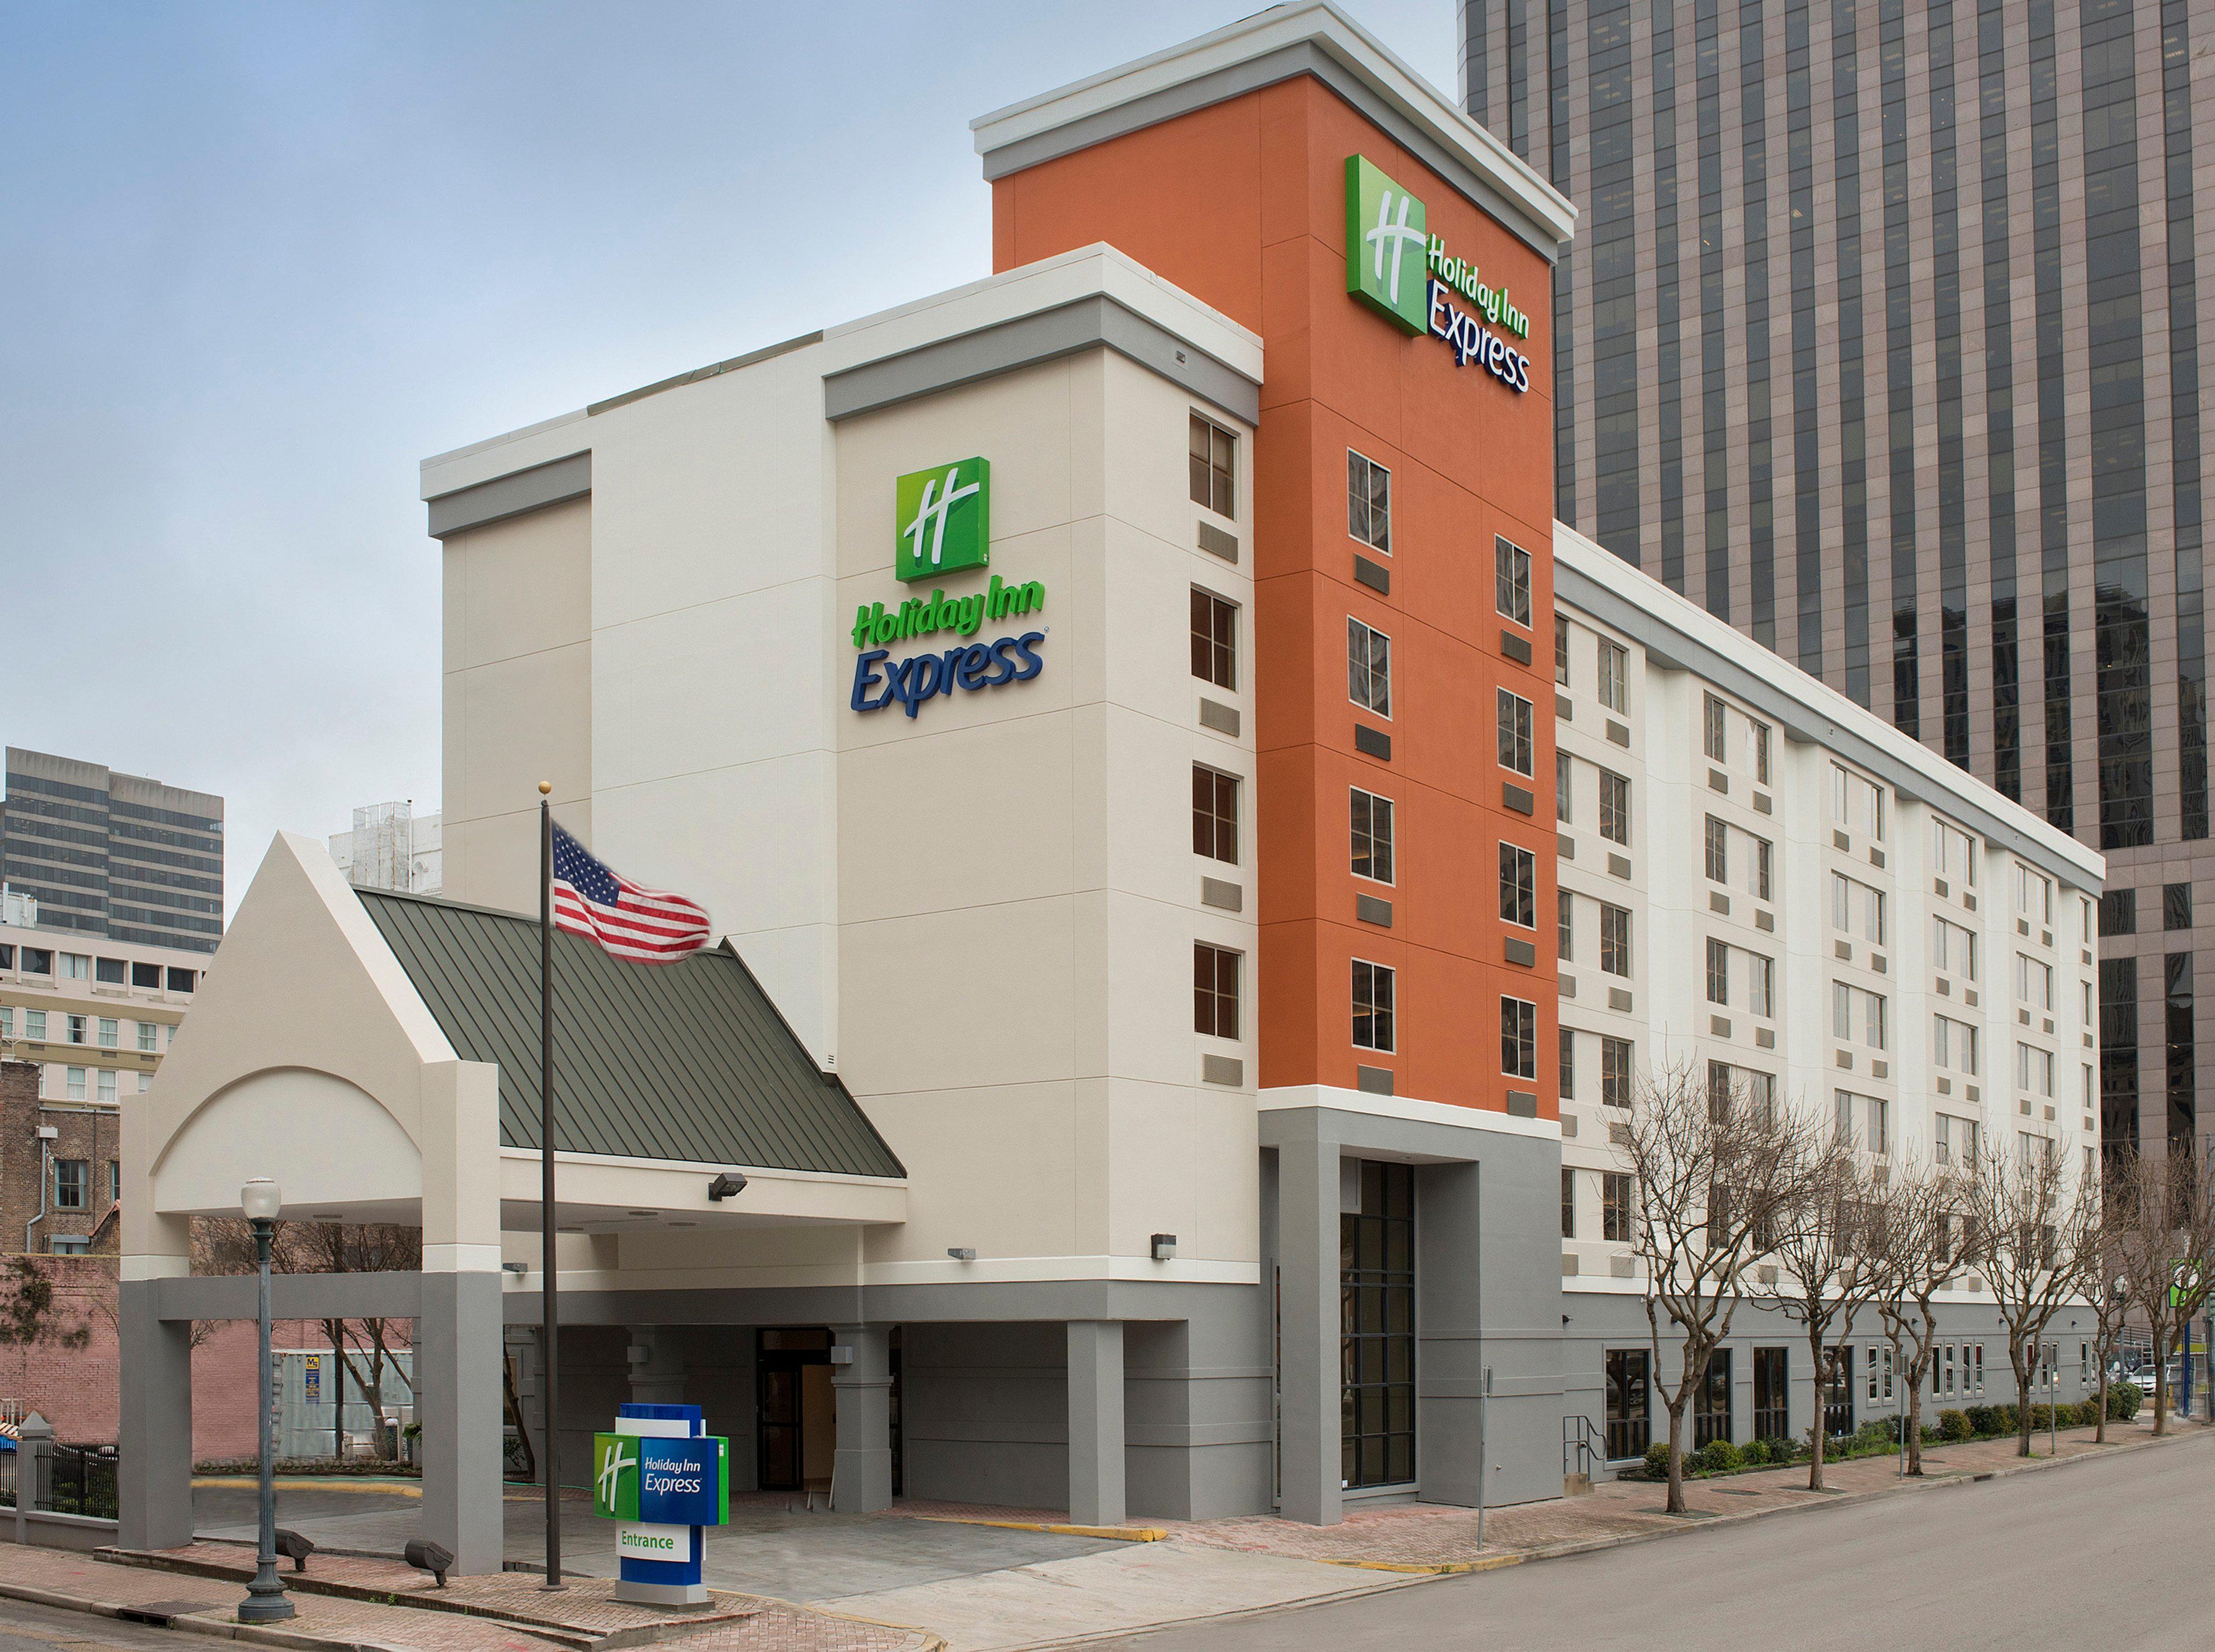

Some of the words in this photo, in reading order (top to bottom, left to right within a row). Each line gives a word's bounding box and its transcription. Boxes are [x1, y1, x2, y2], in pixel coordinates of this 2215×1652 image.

[1426, 233, 1500, 324] Holiday
[1498, 287, 1530, 339] Inn
[1427, 279, 1530, 393] Express
[851, 589, 986, 649] Holiday
[986, 575, 1045, 621] Inn
[850, 631, 1045, 718] Express
[645, 1457, 682, 1474] Holiday
[683, 1459, 701, 1471] Inn
[645, 1473, 701, 1496] Express
[621, 1531, 674, 1550] Entrance
